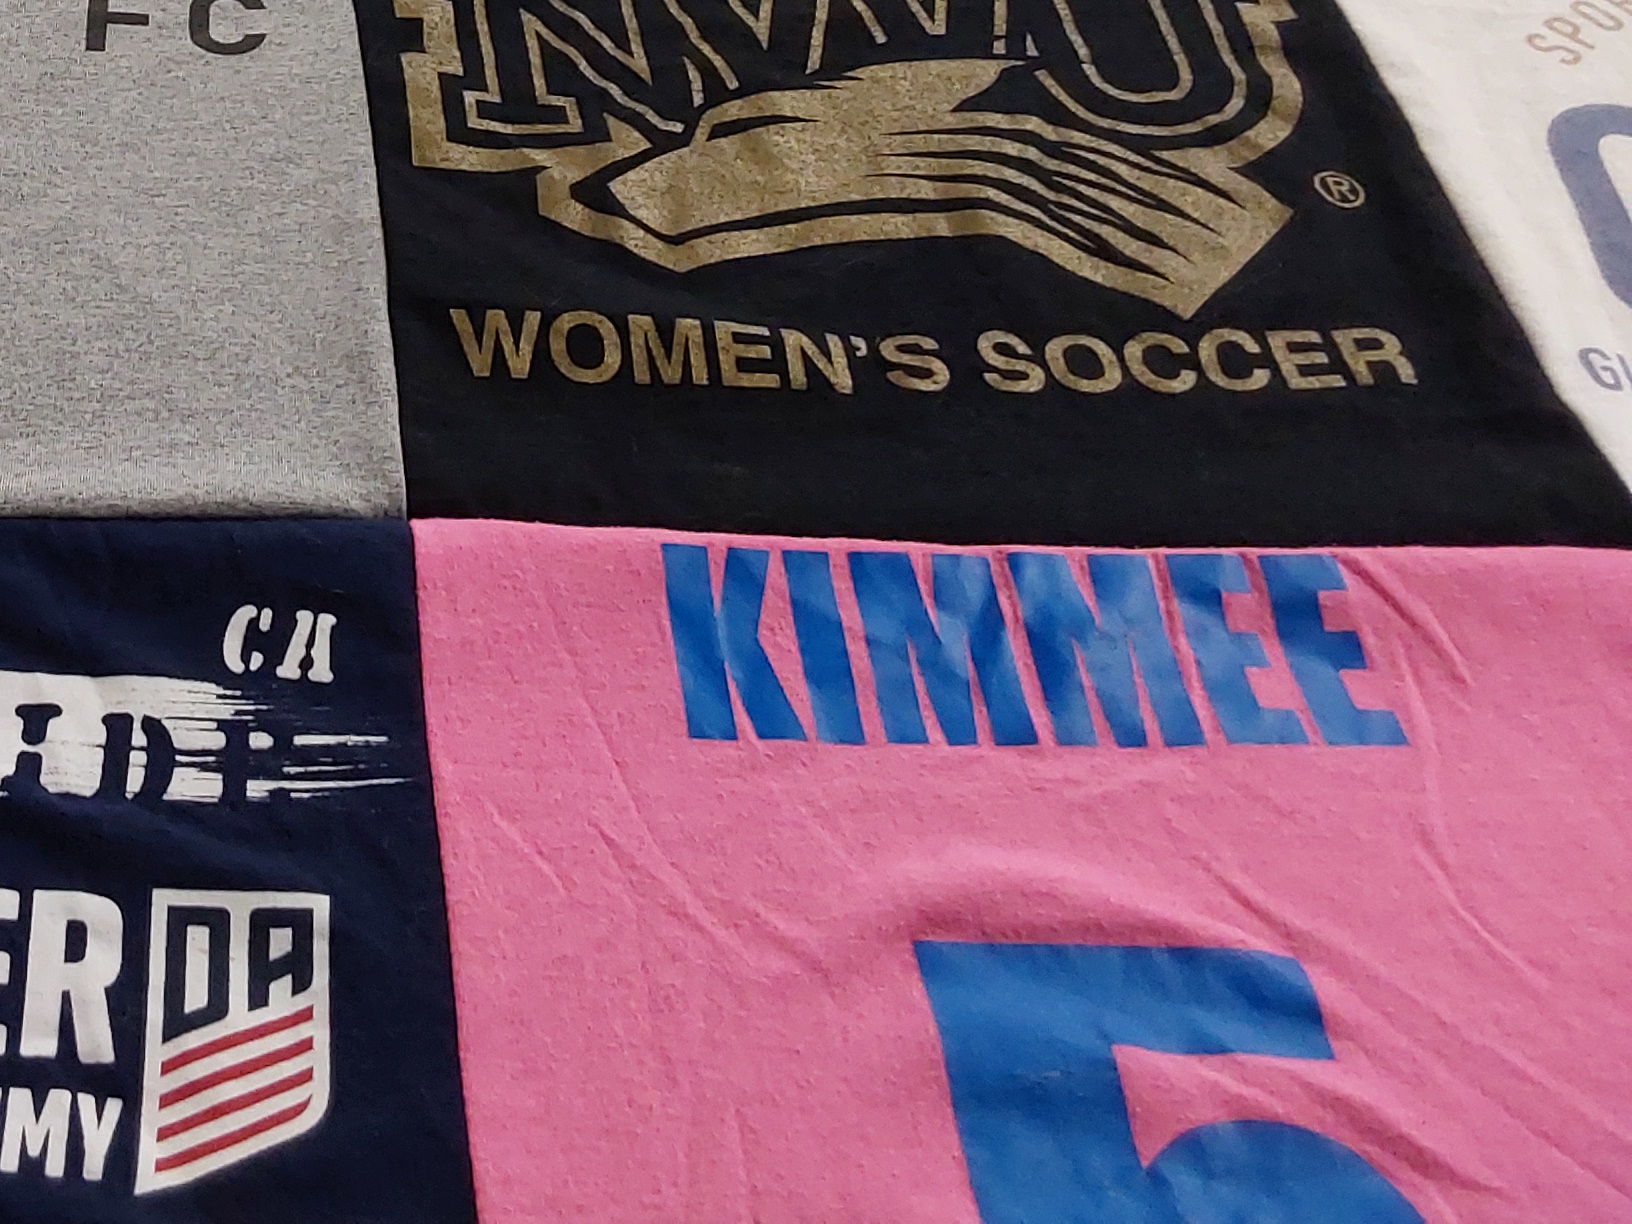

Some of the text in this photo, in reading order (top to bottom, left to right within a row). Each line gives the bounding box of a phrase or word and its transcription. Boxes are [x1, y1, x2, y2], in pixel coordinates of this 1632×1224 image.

[450, 309, 1418, 394] WOMEN'S SOCCER
[223, 605, 336, 682] CA
[661, 543, 1410, 748] KIMMEE
[166, 906, 316, 1038] DA
